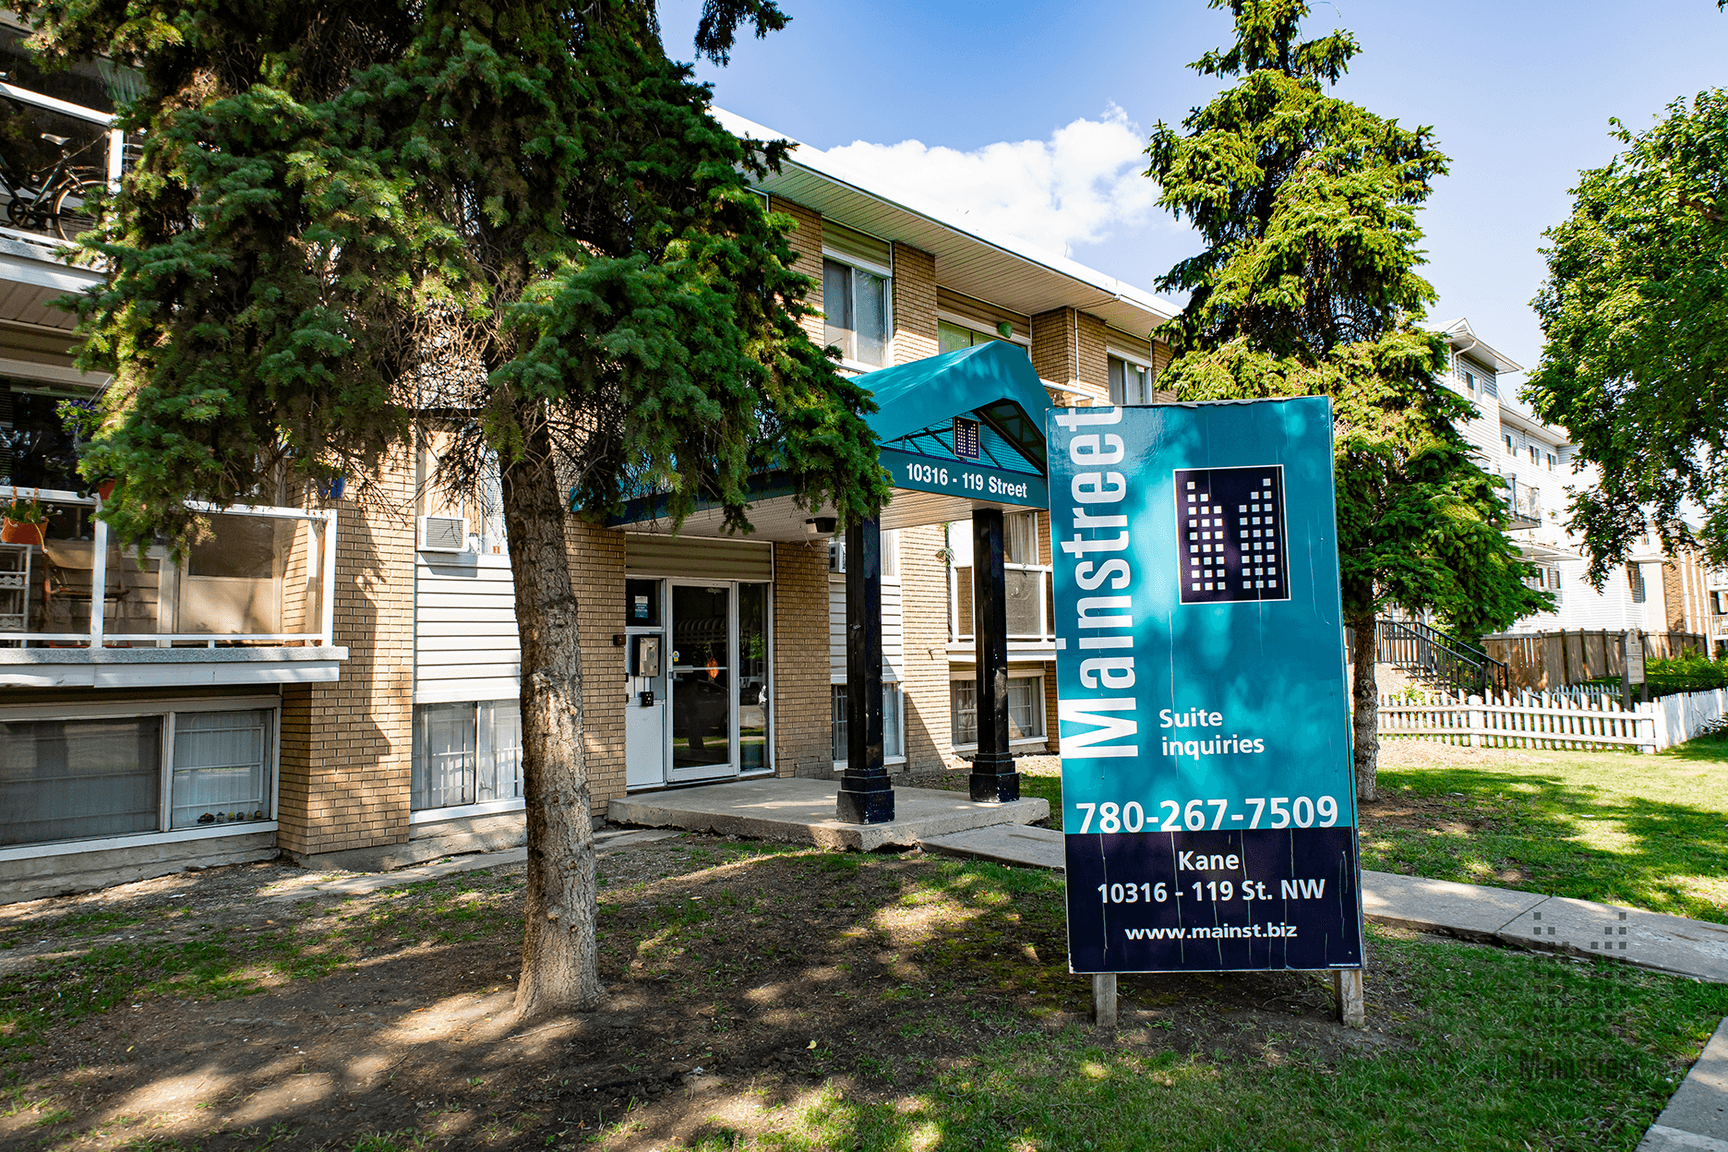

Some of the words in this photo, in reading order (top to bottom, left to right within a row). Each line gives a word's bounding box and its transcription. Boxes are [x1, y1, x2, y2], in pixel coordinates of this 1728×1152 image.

[906, 462, 949, 486] 10316
[962, 472, 984, 491] 119
[988, 475, 1028, 499] Street
[1054, 406, 1139, 760] Mainstreet
[1159, 706, 1224, 729] Suite
[1161, 733, 1266, 762] inquiries
[1075, 795, 1339, 835] 780-267-7509
[1177, 849, 1240, 872] Kane
[1096, 881, 1168, 904] 10316
[1191, 880, 1234, 902] 119
[1241, 879, 1273, 901] St.
[1280, 878, 1326, 900] NW
[1124, 922, 1299, 940] www.mainst.biz
